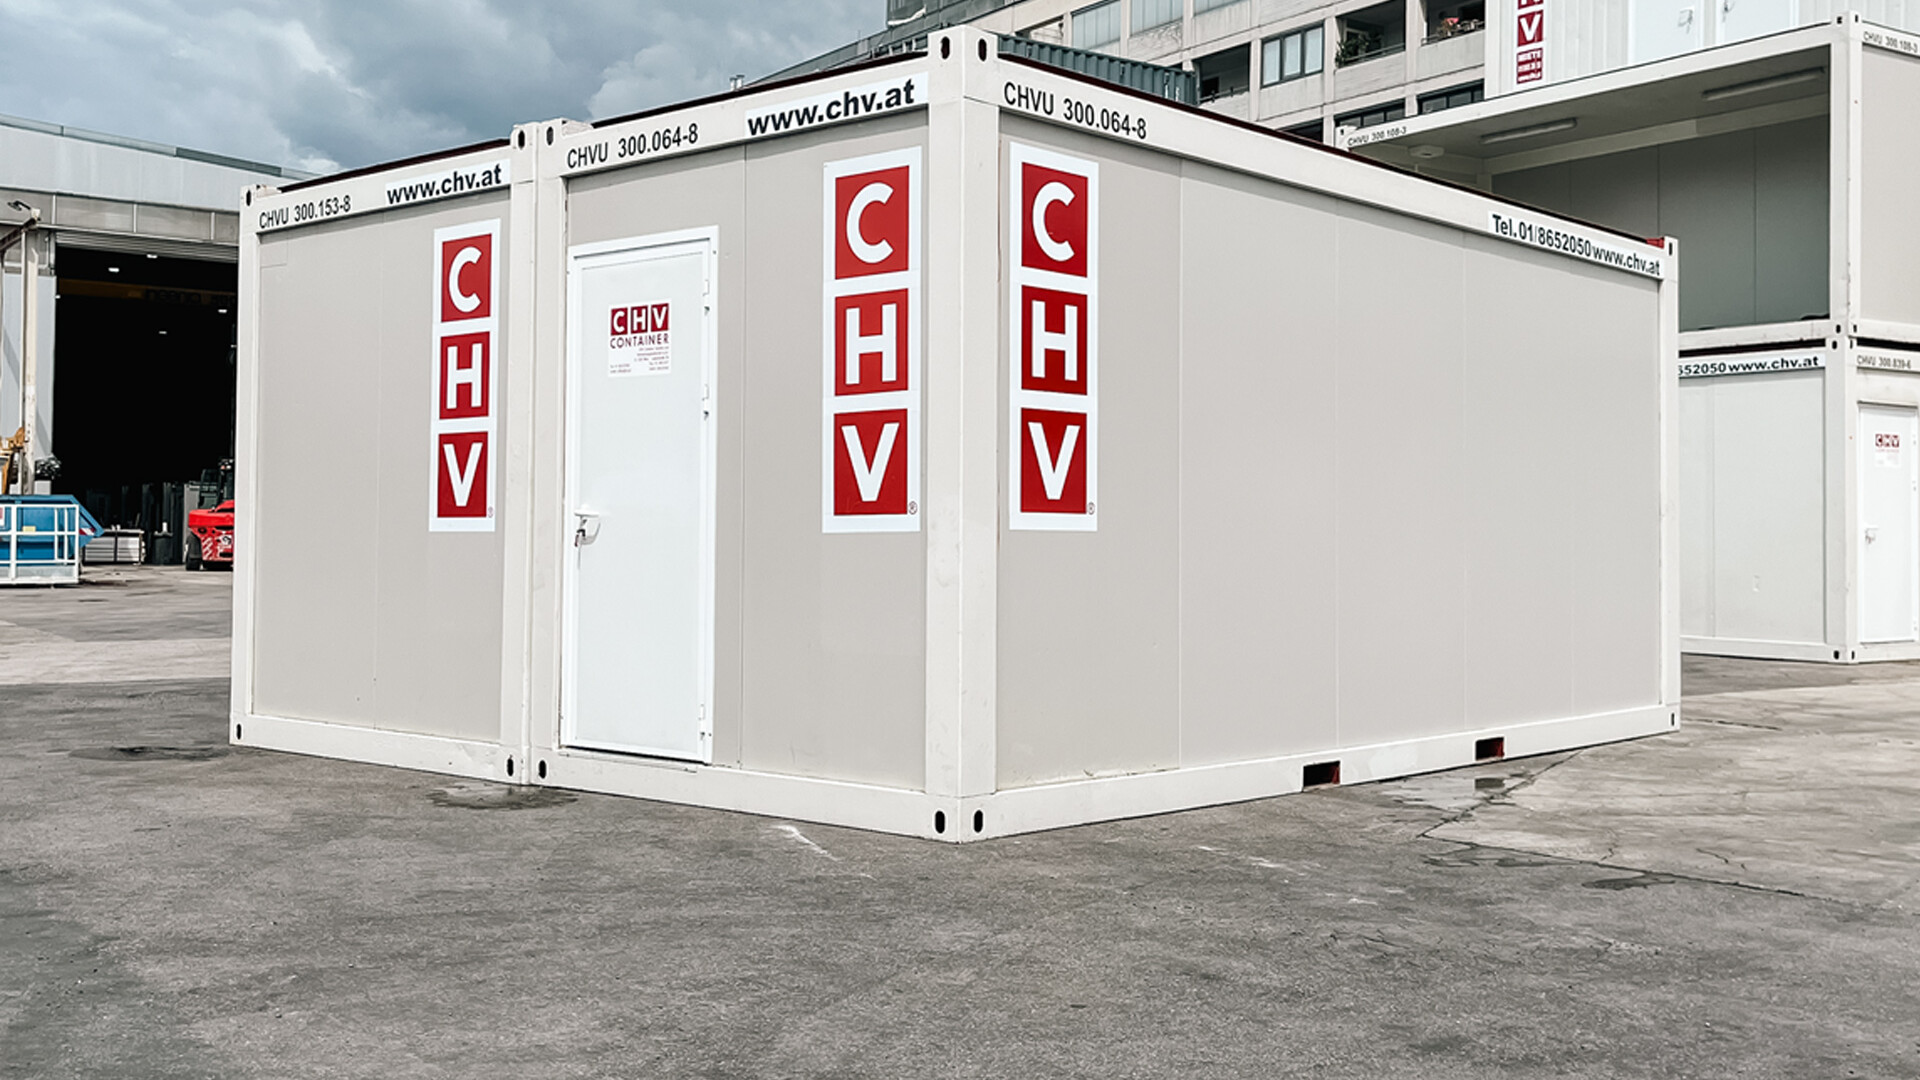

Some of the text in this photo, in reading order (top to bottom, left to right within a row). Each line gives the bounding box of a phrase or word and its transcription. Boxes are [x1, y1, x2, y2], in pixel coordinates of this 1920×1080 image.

[748, 79, 915, 136] www.chv.at
[1004, 81, 1146, 139] CHVU 300.064-8
[567, 123, 699, 169] CHVU 300.064-8
[387, 163, 502, 204] www.chv.at
[259, 195, 351, 229] CHVU 300.153-8
[1592, 245, 1661, 275] www.chv.at
[612, 304, 668, 334] CHV
[610, 333, 669, 349] CONTAINER
[1728, 356, 1819, 372] www.chv.at
